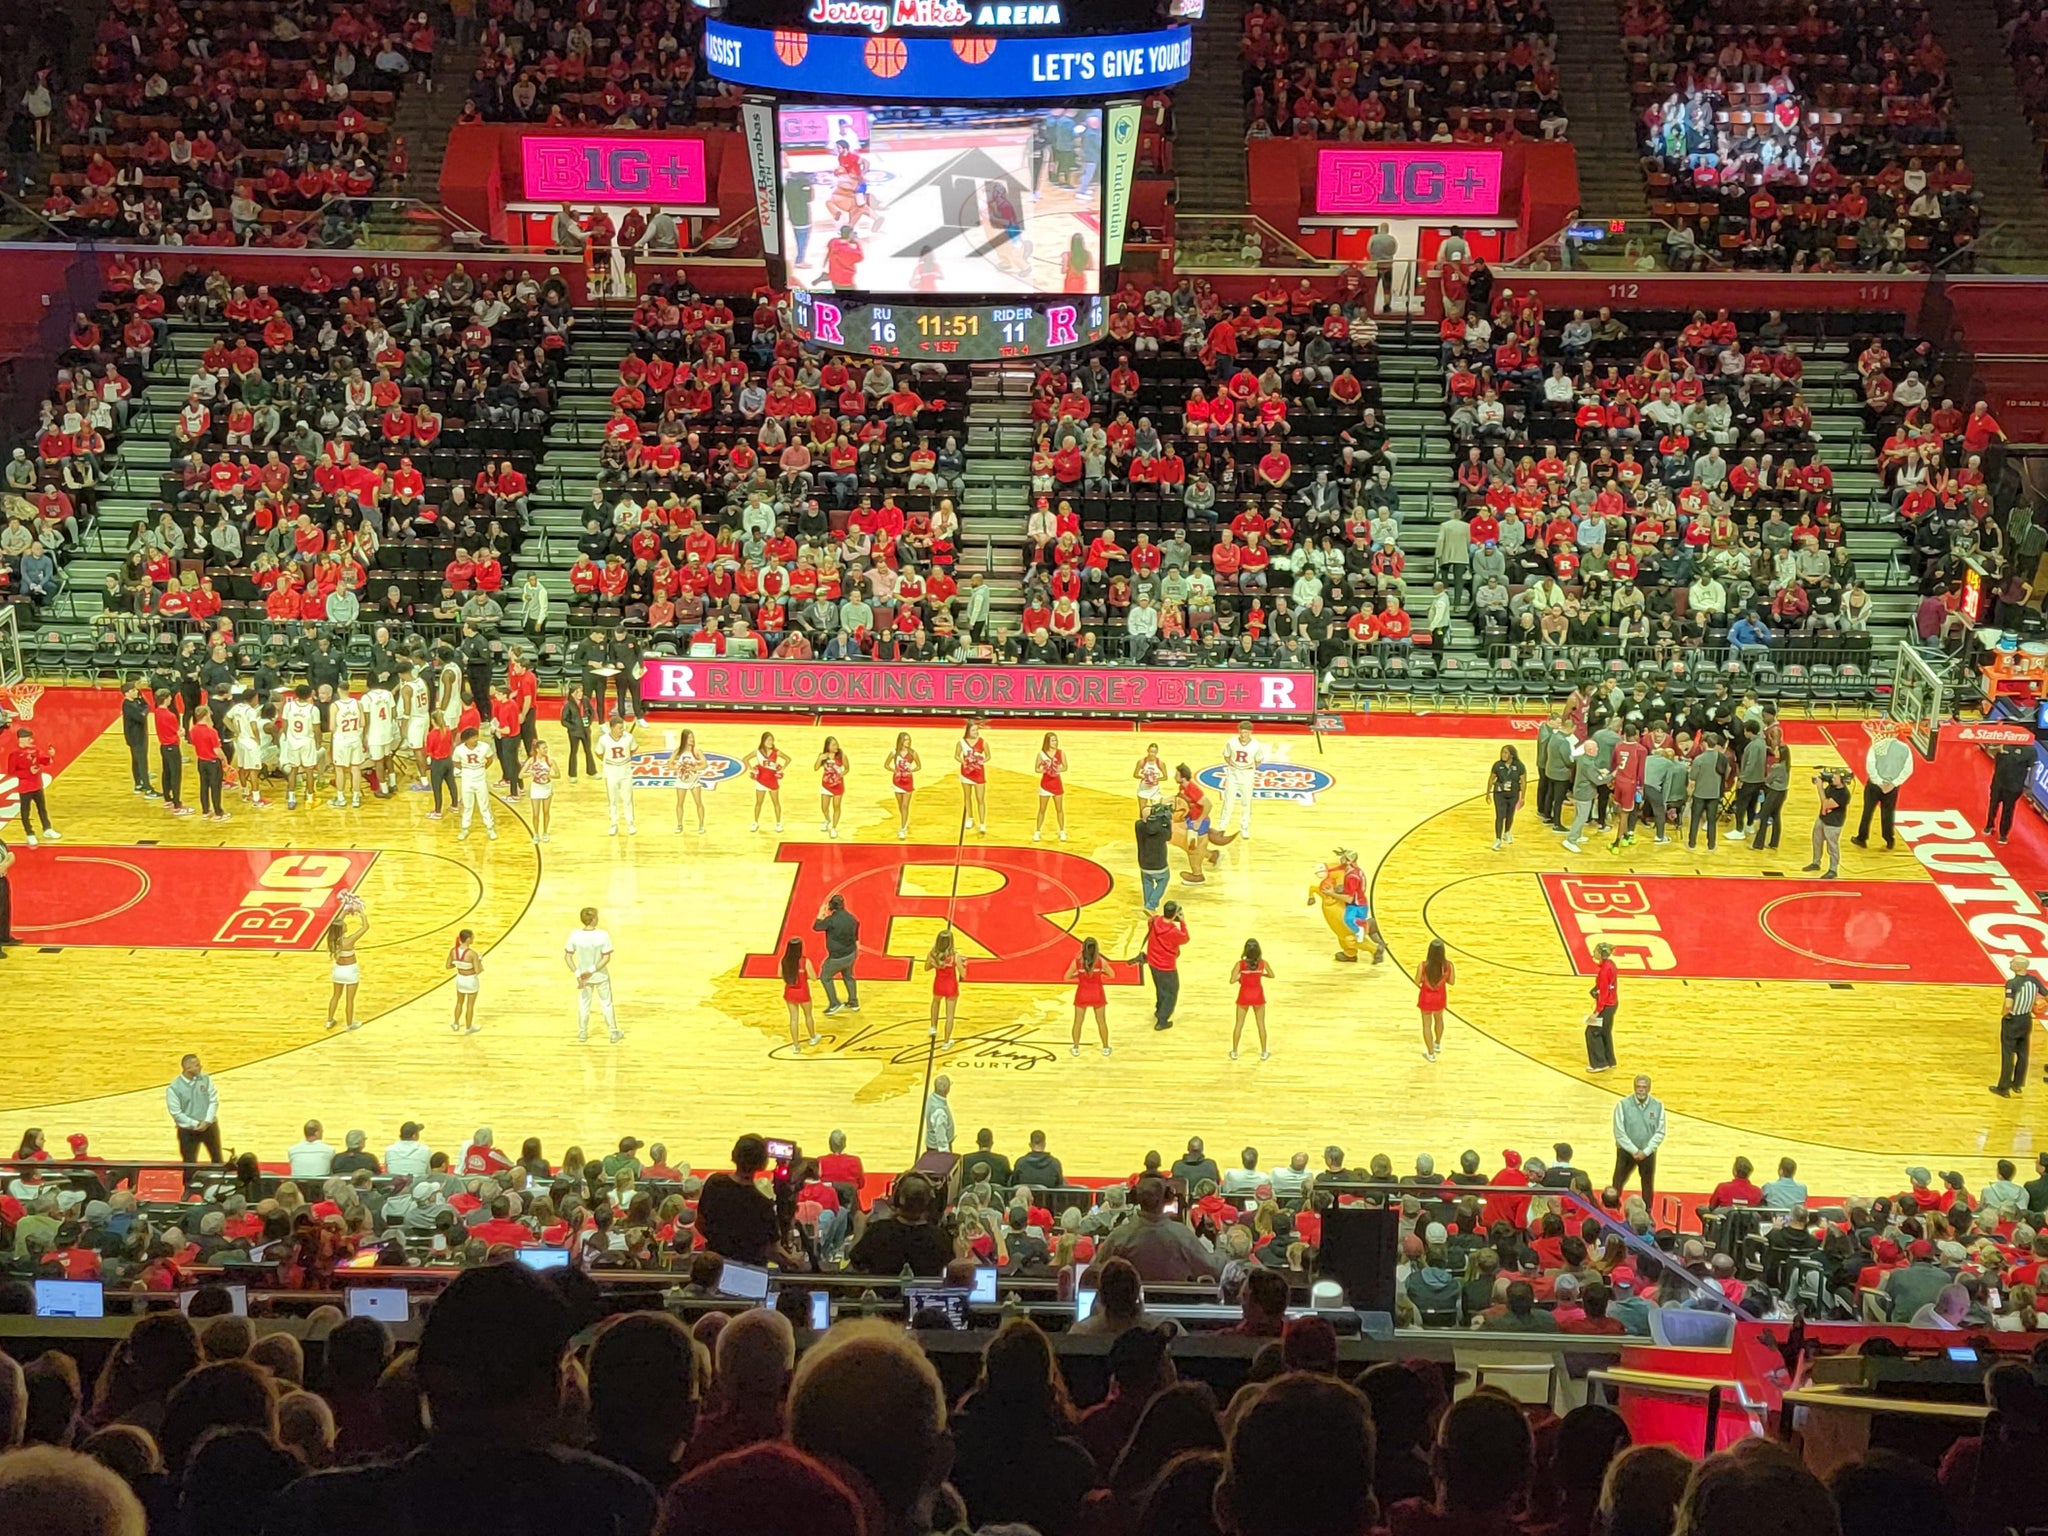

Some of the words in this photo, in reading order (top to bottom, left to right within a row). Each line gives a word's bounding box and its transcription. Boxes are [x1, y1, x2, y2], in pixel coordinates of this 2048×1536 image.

[811, 0, 887, 31] Jersey
[976, 4, 1061, 25] ARENA
[1031, 52, 1096, 81] LET'S
[1102, 48, 1144, 78] GIVE
[1148, 43, 1181, 73] YOUR
[766, 166, 776, 213] HEALTH
[1110, 151, 1128, 239] Prudential
[371, 262, 401, 277] 115
[1608, 284, 1639, 299] 112
[1859, 286, 1890, 301] 111
[872, 307, 892, 320] RU
[993, 307, 1033, 321] RIDER
[813, 301, 845, 345] R
[917, 315, 979, 336] 11:51
[1046, 305, 1078, 347] R
[870, 321, 896, 342] 16
[1002, 322, 1025, 343] 11
[1560, 560, 1571, 570] R
[1358, 623, 1369, 635] R
[660, 665, 695, 696] R
[707, 668, 729, 696] R
[740, 669, 763, 697] U
[774, 670, 934, 700] LOOKING
[945, 673, 1016, 702] FOR
[1025, 675, 1147, 705] MORE?
[1259, 677, 1296, 708] R
[416, 695, 428, 708] 15
[378, 707, 387, 721] 4
[293, 720, 304, 733] 9
[341, 718, 359, 732] 27
[466, 753, 481, 765] R
[611, 747, 625, 759] R
[1235, 751, 1249, 764] R
[1618, 755, 1628, 770] 3
[739, 841, 1144, 986] R
[942, 1061, 1012, 1069] COURT
